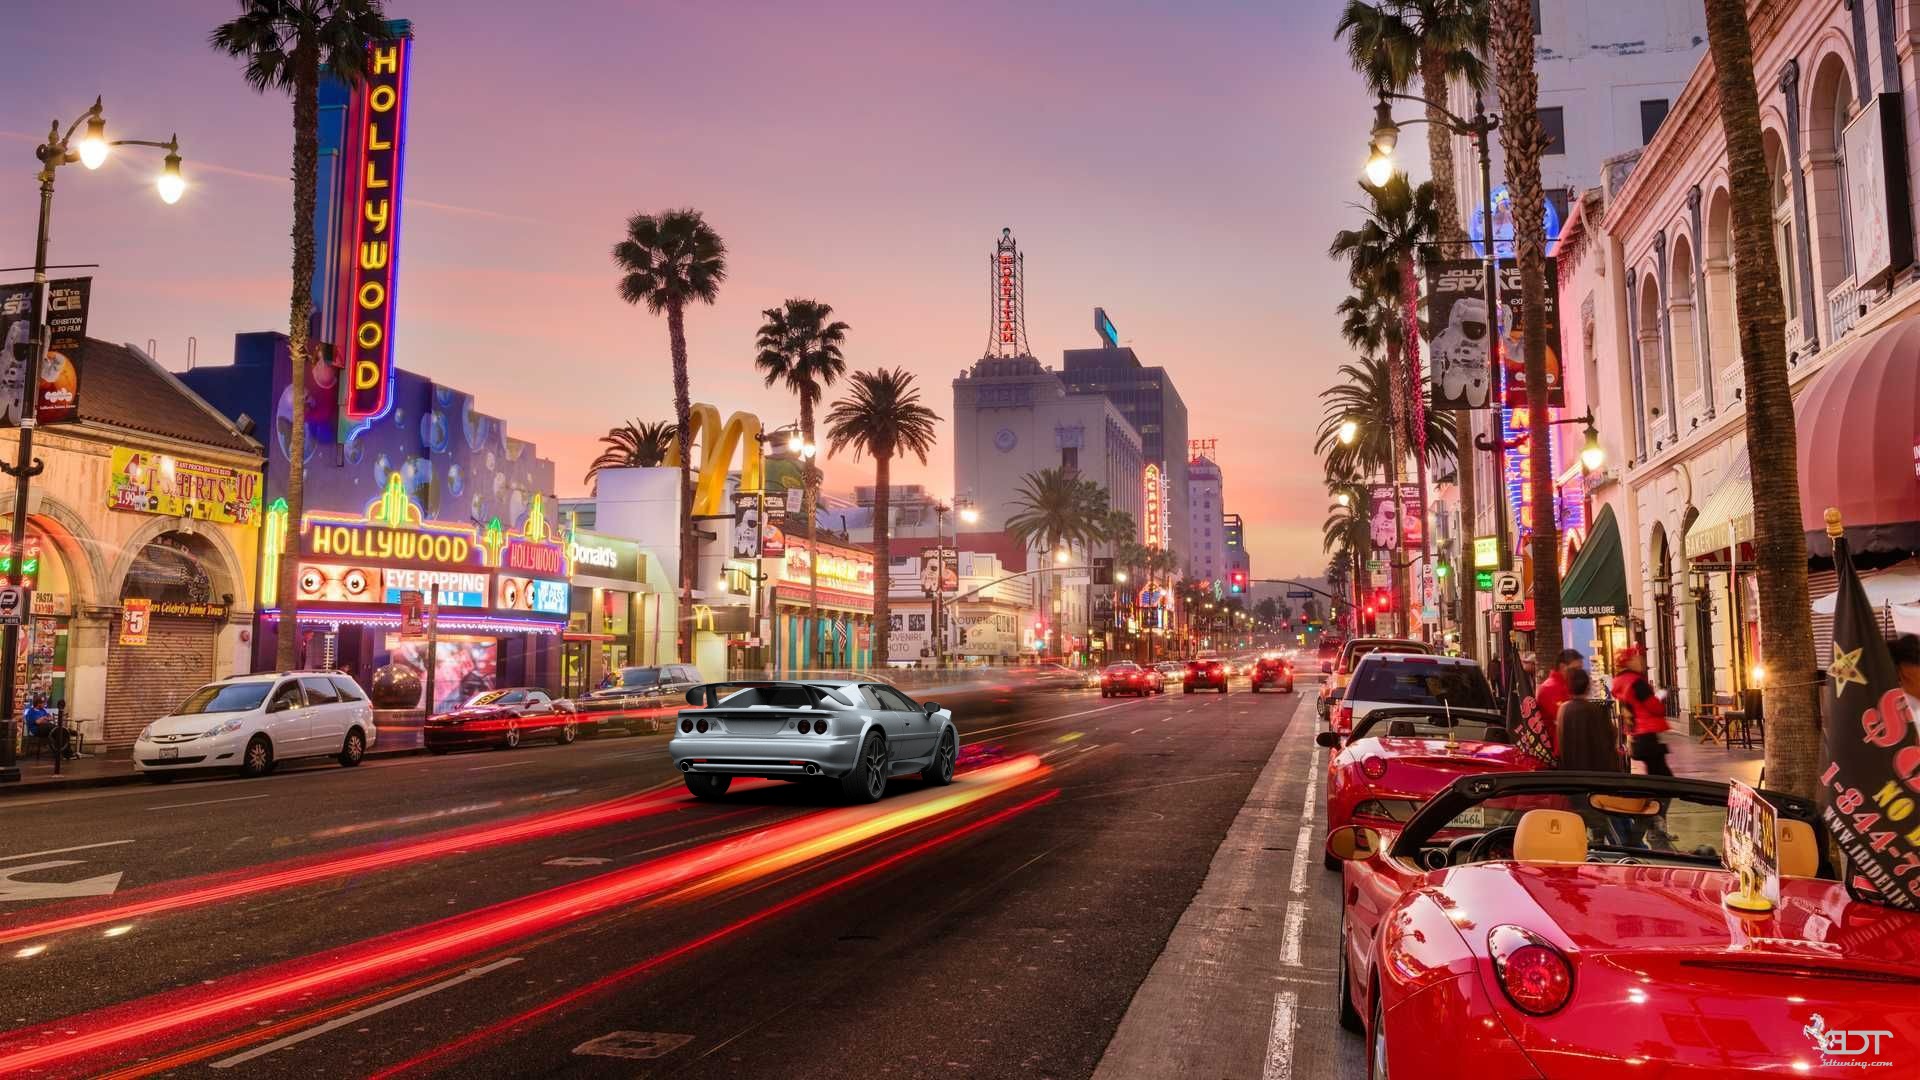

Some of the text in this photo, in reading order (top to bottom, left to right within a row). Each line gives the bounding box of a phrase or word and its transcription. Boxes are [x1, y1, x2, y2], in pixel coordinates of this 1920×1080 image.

[356, 46, 397, 390] HOLLYWOOD
[1148, 481, 1158, 545] CAPITA
[313, 525, 469, 563] HOLLYWOOD
[510, 543, 560, 573] HOLLYWOOD
[386, 569, 485, 592] EYE POPPING
[1562, 605, 1616, 616] CAMERAS GALORE
[1872, 780, 1915, 822] NO
